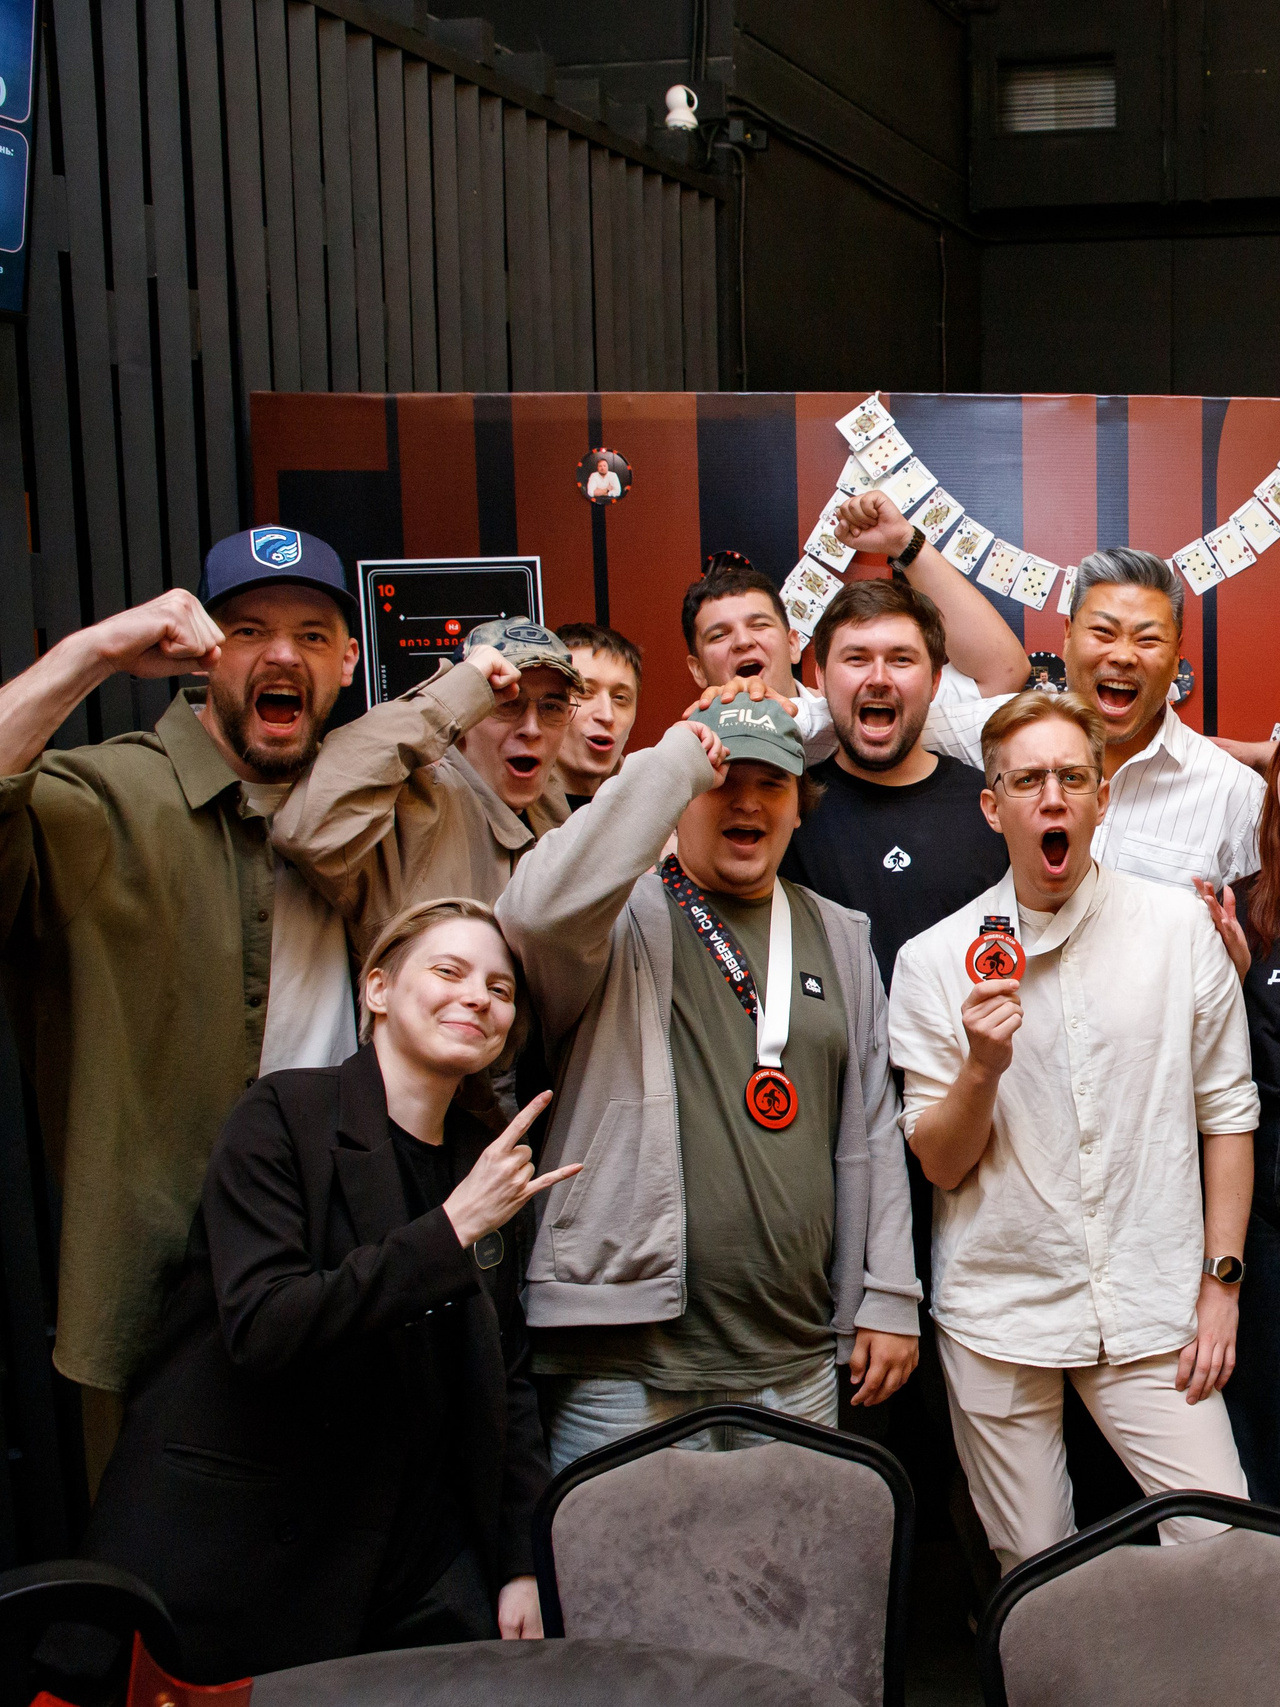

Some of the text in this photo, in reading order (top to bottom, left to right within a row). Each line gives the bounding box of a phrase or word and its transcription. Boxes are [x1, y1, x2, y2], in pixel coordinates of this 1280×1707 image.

[377, 584, 395, 597] 10
[399, 638, 465, 647] USE CLUB
[719, 708, 776, 730] FILA
[691, 905, 745, 982] SIBERIA CUP
[1005, 936, 1016, 945] CUP
